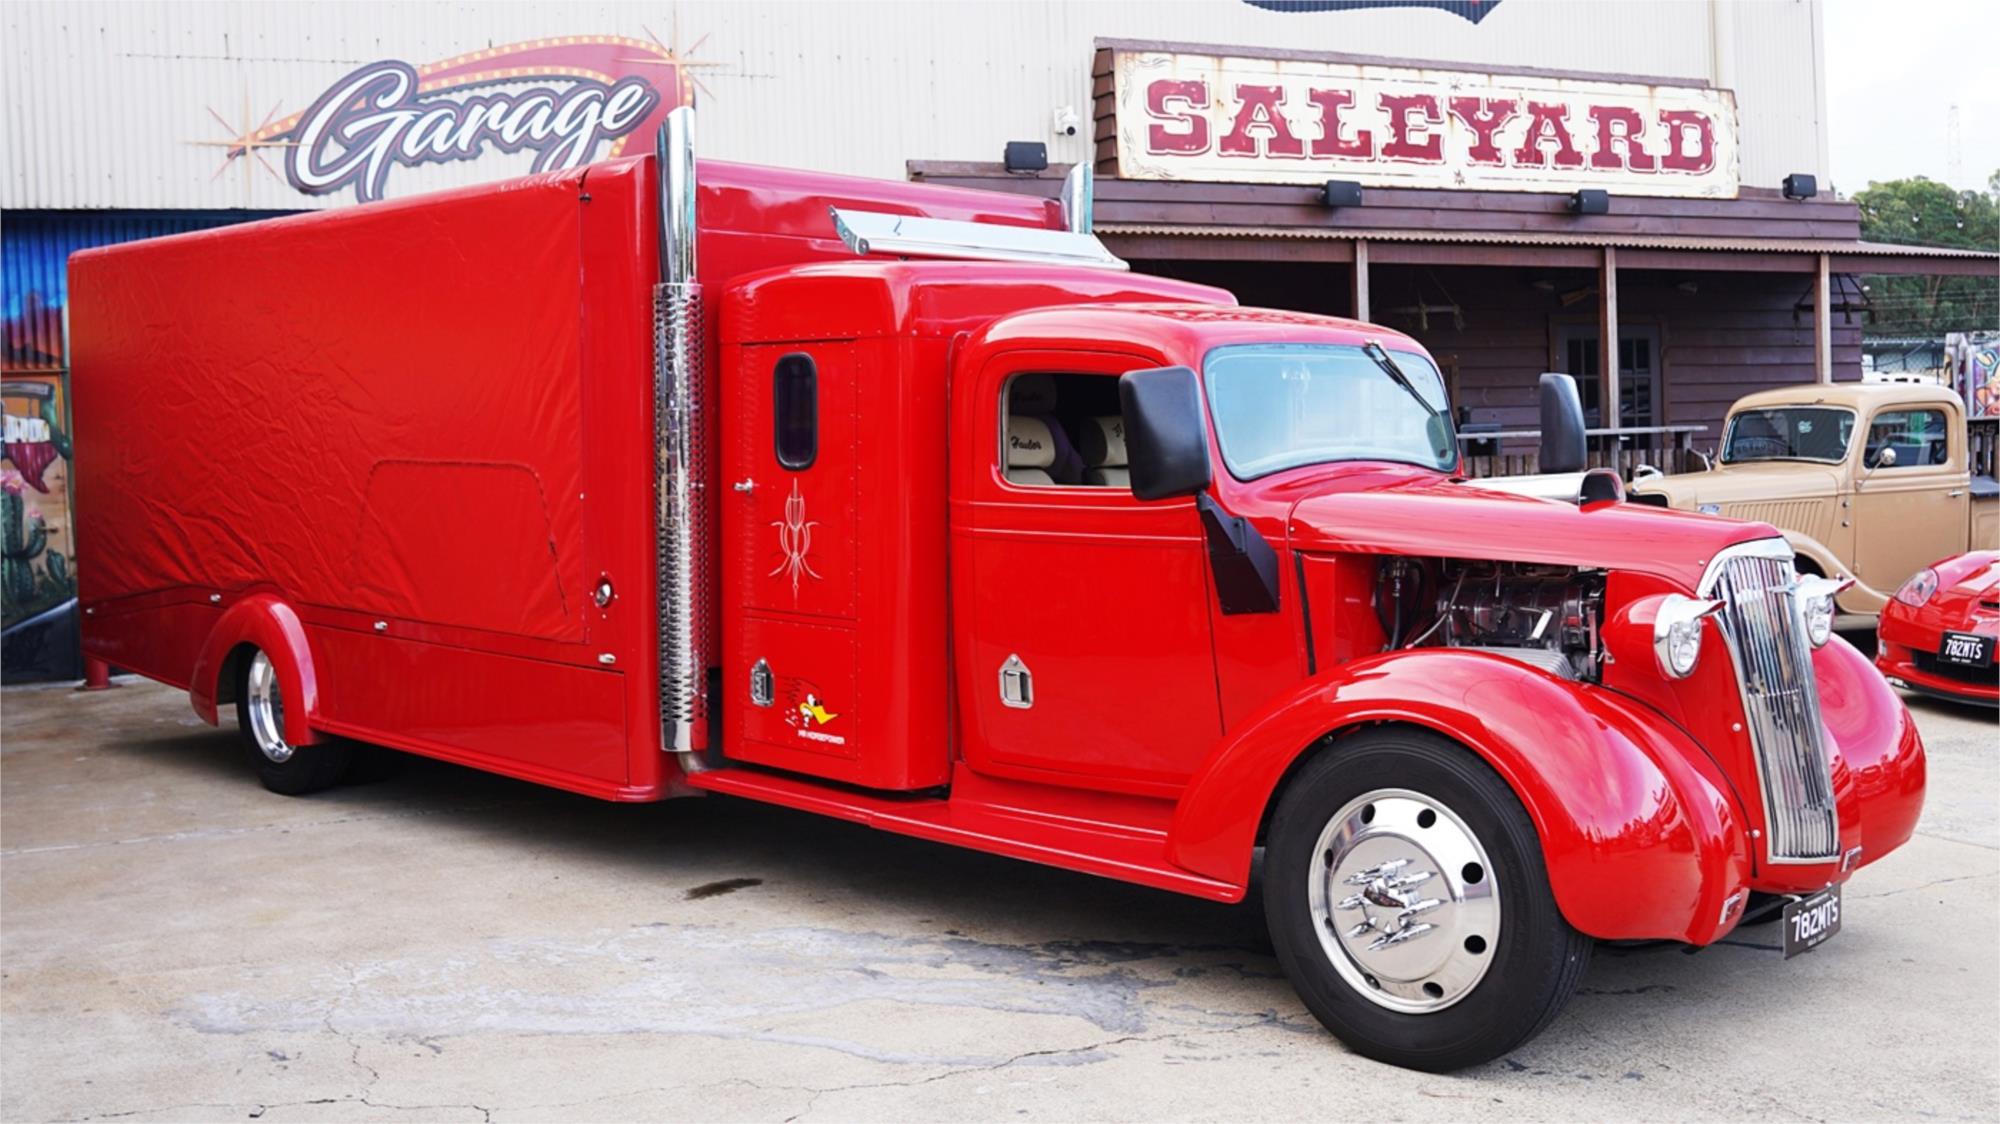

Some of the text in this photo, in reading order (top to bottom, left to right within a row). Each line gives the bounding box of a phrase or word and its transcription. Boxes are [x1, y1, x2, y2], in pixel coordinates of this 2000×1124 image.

[292, 66, 652, 200] Garage
[1145, 79, 1718, 176] SALEYARD
[1945, 639, 1983, 660] 782MTS
[1791, 896, 1838, 943] 782MTS
